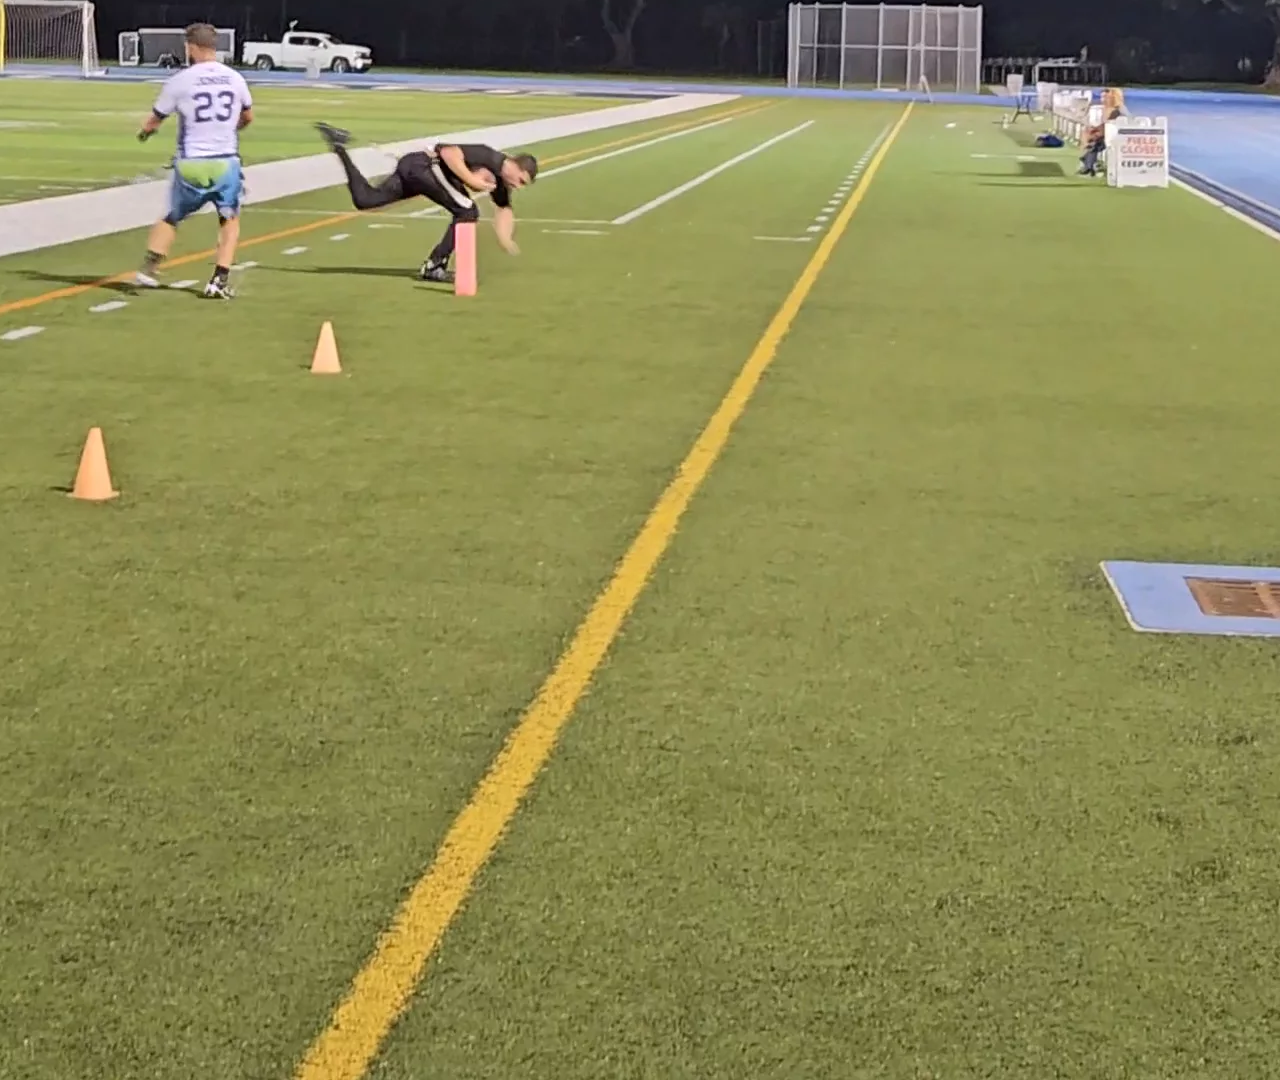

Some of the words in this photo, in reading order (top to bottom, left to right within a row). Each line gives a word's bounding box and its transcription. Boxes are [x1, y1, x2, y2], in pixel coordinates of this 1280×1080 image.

[192, 90, 235, 123] 23
[1127, 136, 1157, 145] FIELD
[1120, 146, 1164, 154] CLOSED
[1121, 160, 1144, 168] KEEP
[1145, 160, 1164, 168] OFF
